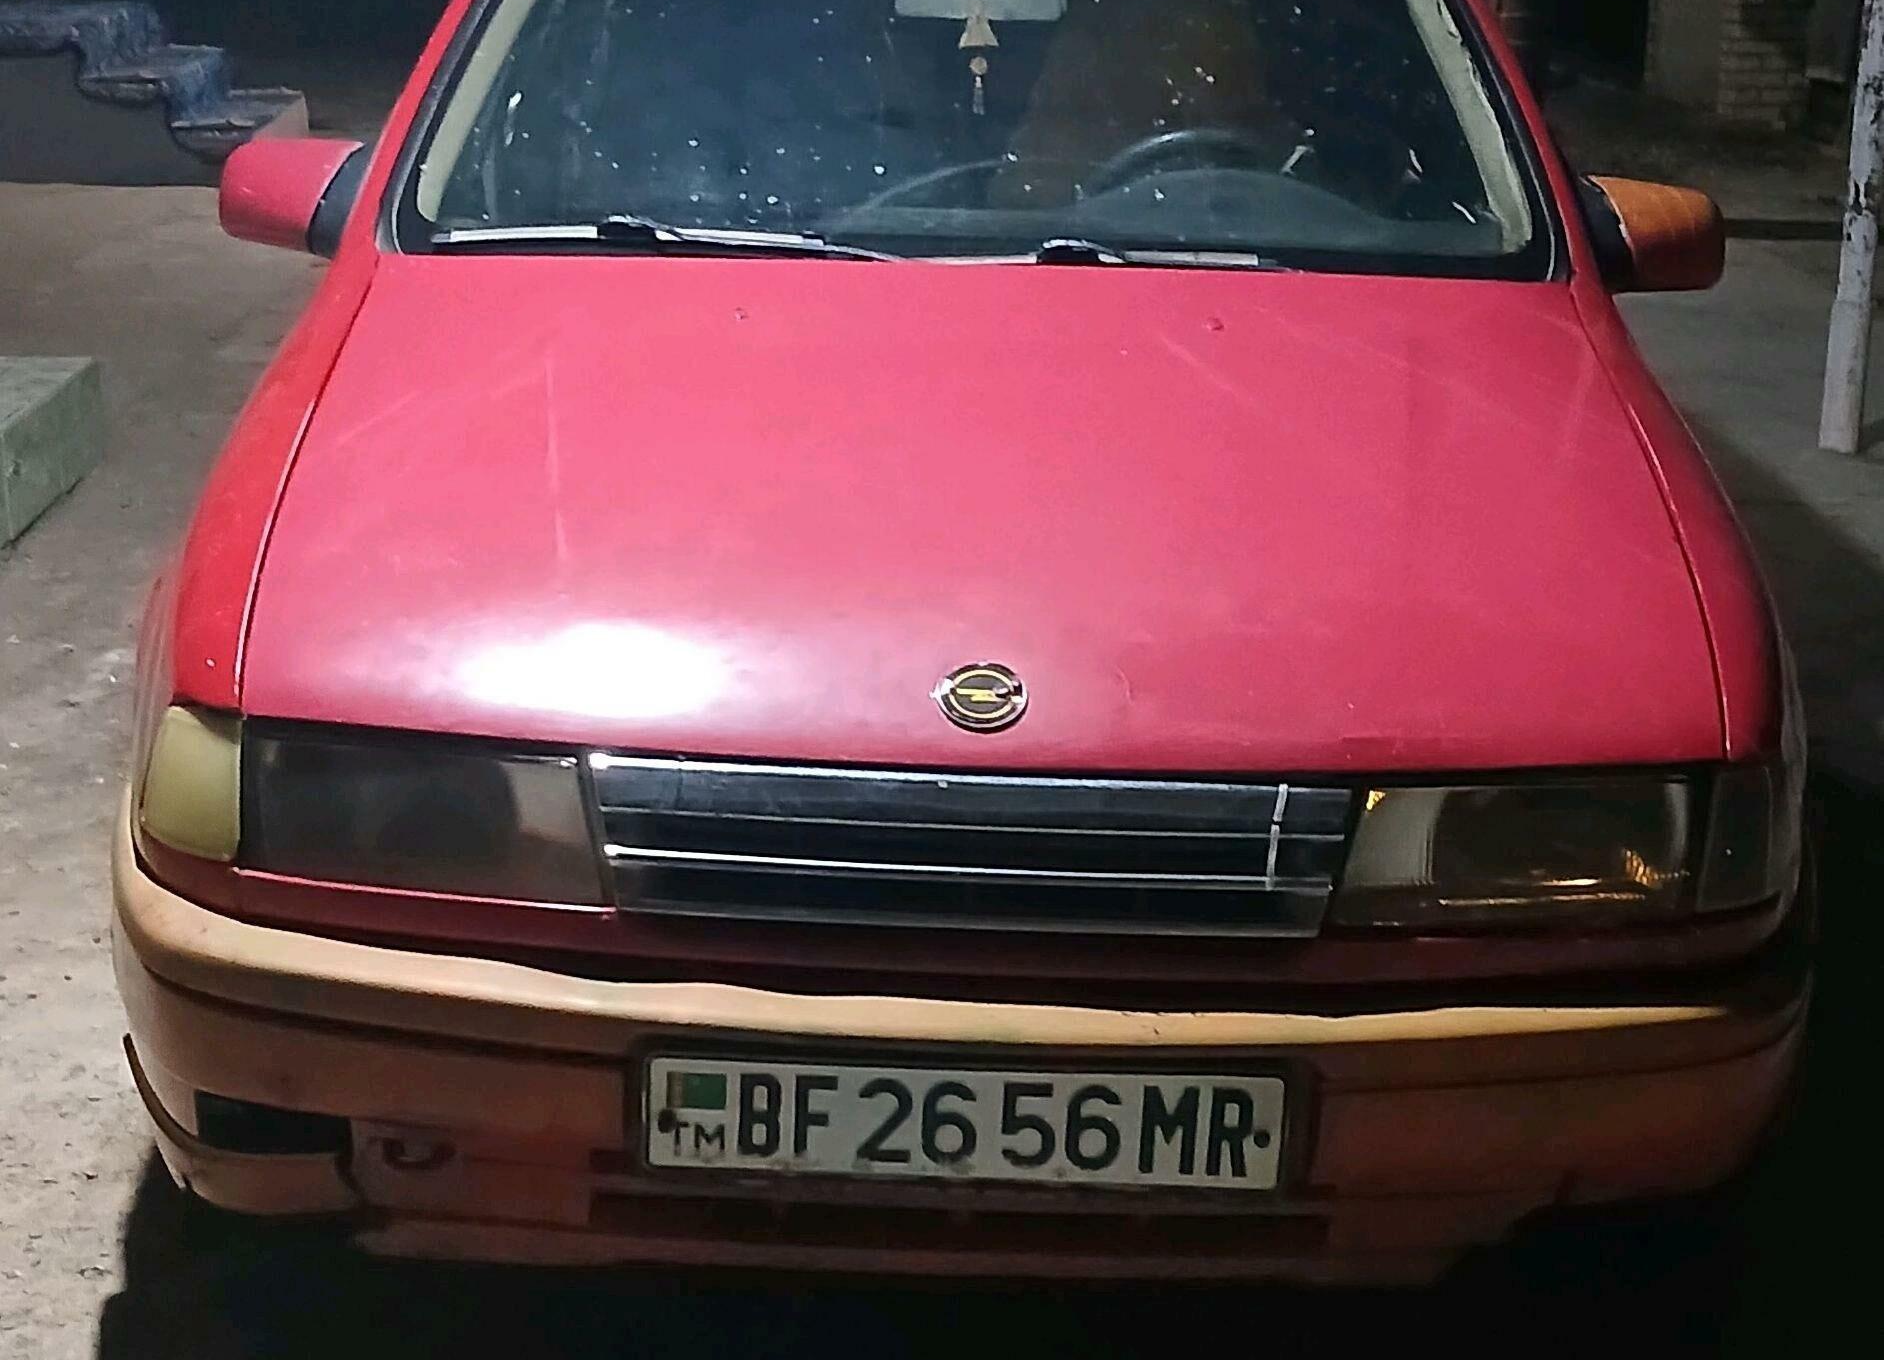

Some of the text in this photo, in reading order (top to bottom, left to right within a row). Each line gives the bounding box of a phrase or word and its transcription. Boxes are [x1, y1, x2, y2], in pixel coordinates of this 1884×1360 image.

[669, 1121, 725, 1157] TM
[736, 1073, 1254, 1178] BF 26 56 MR
